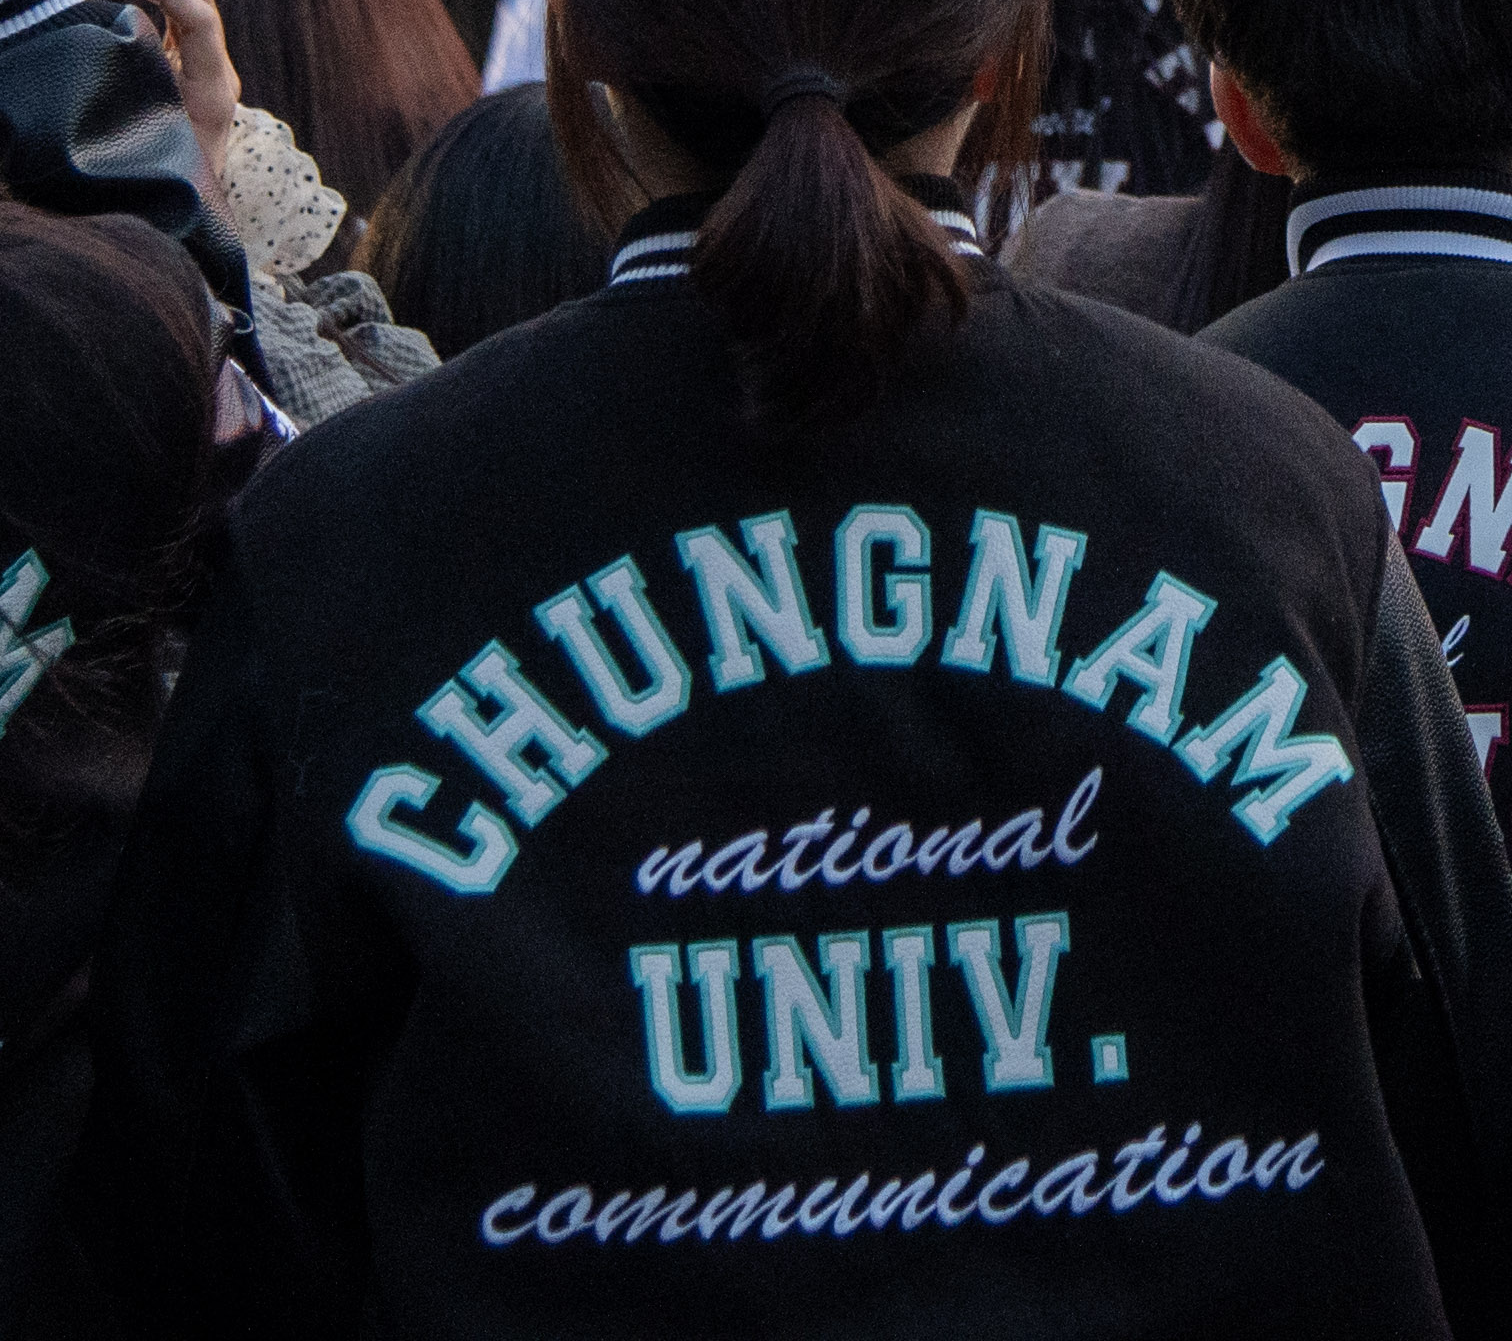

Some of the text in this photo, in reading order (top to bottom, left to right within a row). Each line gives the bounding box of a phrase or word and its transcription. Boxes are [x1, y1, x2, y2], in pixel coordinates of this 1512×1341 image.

[346, 505, 1354, 894] CHUNGNAM
[635, 766, 1102, 897] national
[629, 911, 1129, 1113] UNIV.
[479, 1121, 1326, 1246] communication
